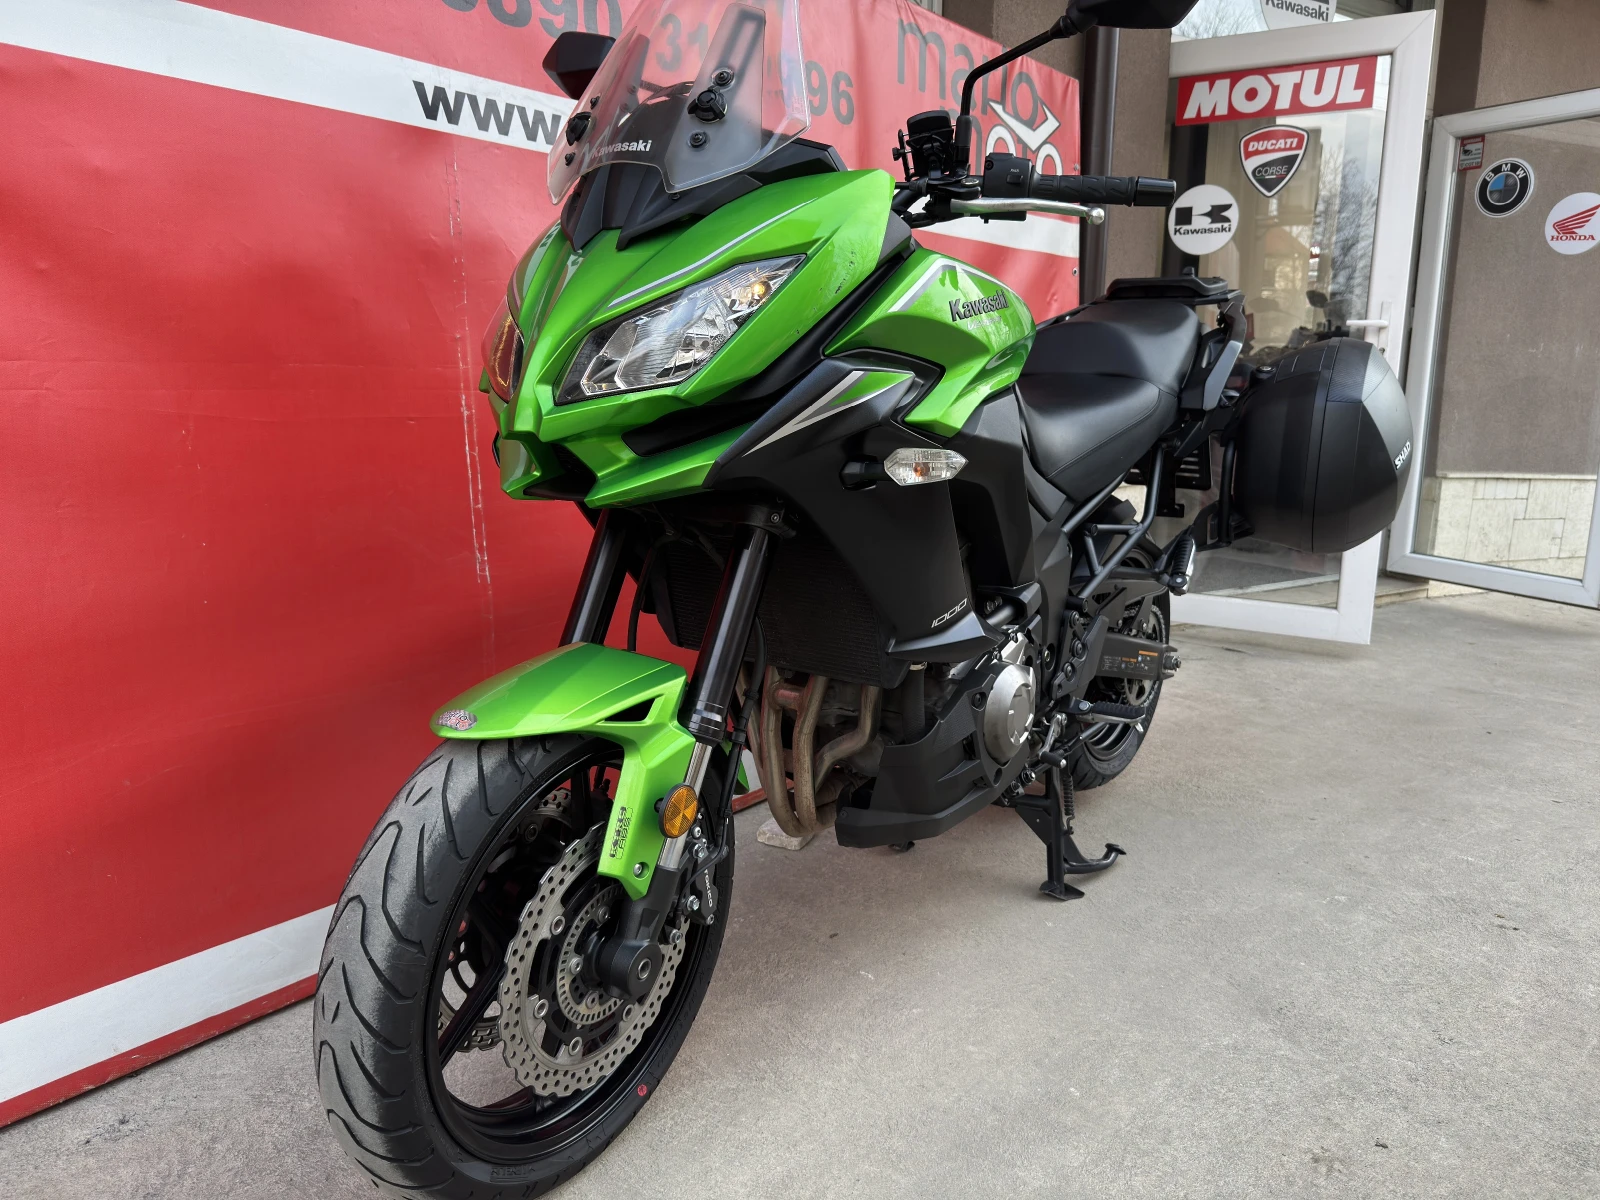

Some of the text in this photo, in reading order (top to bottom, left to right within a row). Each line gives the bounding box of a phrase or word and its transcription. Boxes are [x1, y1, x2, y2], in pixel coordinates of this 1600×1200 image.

[1183, 64, 1365, 120] MOTUL
[592, 140, 652, 158] Kawasaki
[1248, 138, 1298, 152] DUCATI
[1255, 165, 1289, 177] CORSE
[1485, 162, 1526, 182] BMW
[1173, 223, 1232, 236] Kawasaki
[1550, 234, 1596, 242] HONDA
[949, 289, 1010, 322] Kawasaki
[1394, 440, 1411, 470] SHAD
[931, 597, 968, 629] 1000
